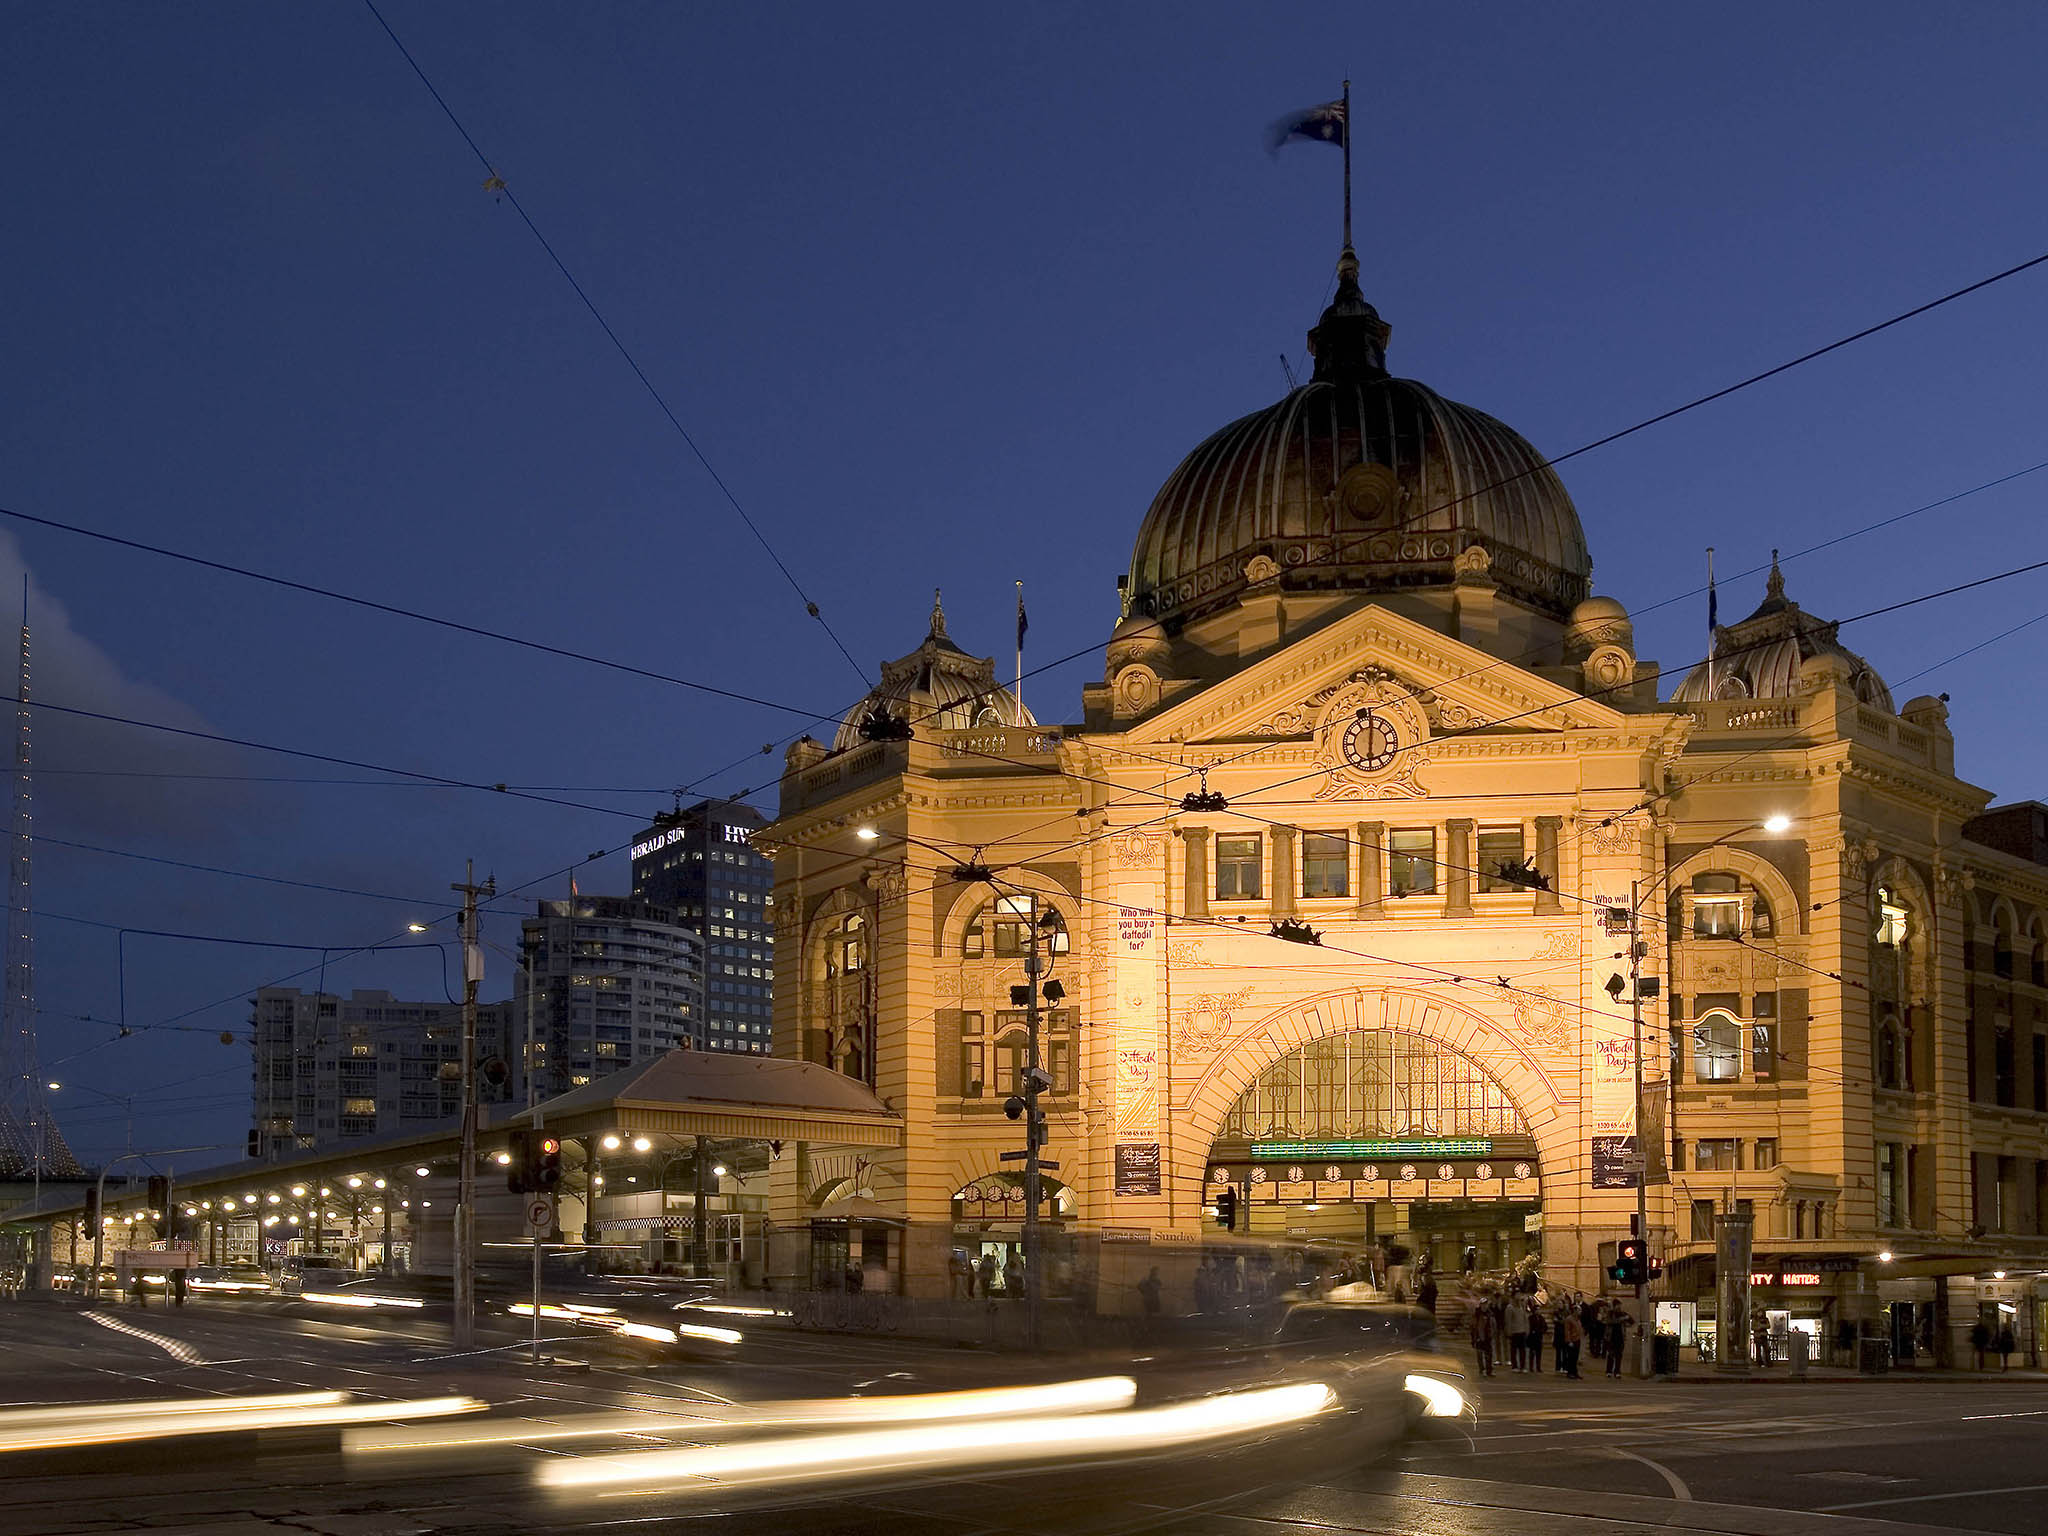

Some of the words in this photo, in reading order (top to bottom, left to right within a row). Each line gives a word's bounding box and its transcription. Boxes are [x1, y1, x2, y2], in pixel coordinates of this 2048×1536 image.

[630, 834, 665, 860] HERALD
[667, 827, 685, 845] SUN
[1594, 895, 1613, 903] Who
[1614, 894, 1629, 903] will
[1119, 908, 1137, 917] Who
[1138, 907, 1153, 917] will
[1118, 920, 1132, 930] you
[1134, 919, 1148, 929] buy
[1149, 920, 1155, 928] a
[1121, 930, 1152, 939] daffodil
[1129, 941, 1145, 950] for?
[1596, 1039, 1633, 1053] Daffodil
[1606, 1053, 1628, 1075] Day
[1130, 1064, 1149, 1084] Day
[1154, 1231, 1195, 1243] Sunday
[1750, 1273, 1773, 1285] ITY
[1782, 1273, 1820, 1285] HATTERS
